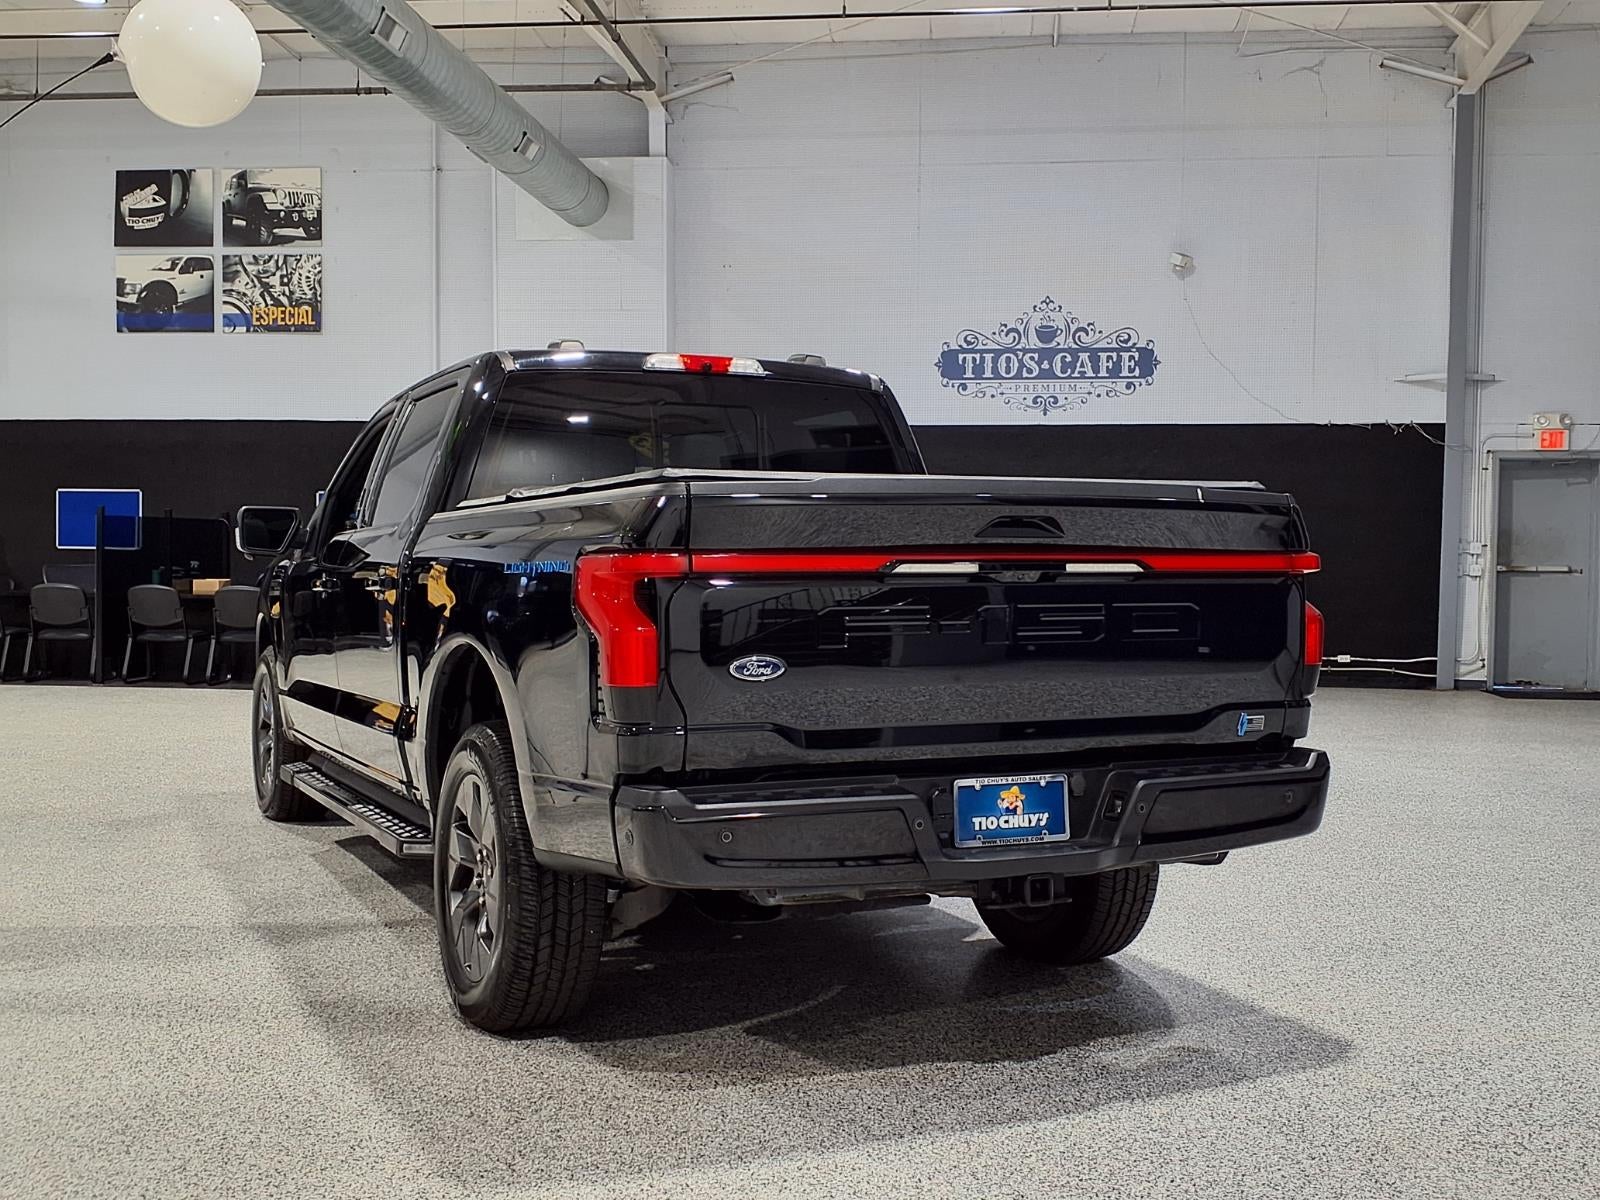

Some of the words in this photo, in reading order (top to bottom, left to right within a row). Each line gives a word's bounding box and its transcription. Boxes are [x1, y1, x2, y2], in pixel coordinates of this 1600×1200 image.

[252, 305, 316, 326] ESPECIAL
[958, 351, 1040, 378] TIO'S
[1014, 383, 1078, 393] PREMIUM
[1540, 431, 1565, 449] EXIT
[743, 661, 774, 676] Ford
